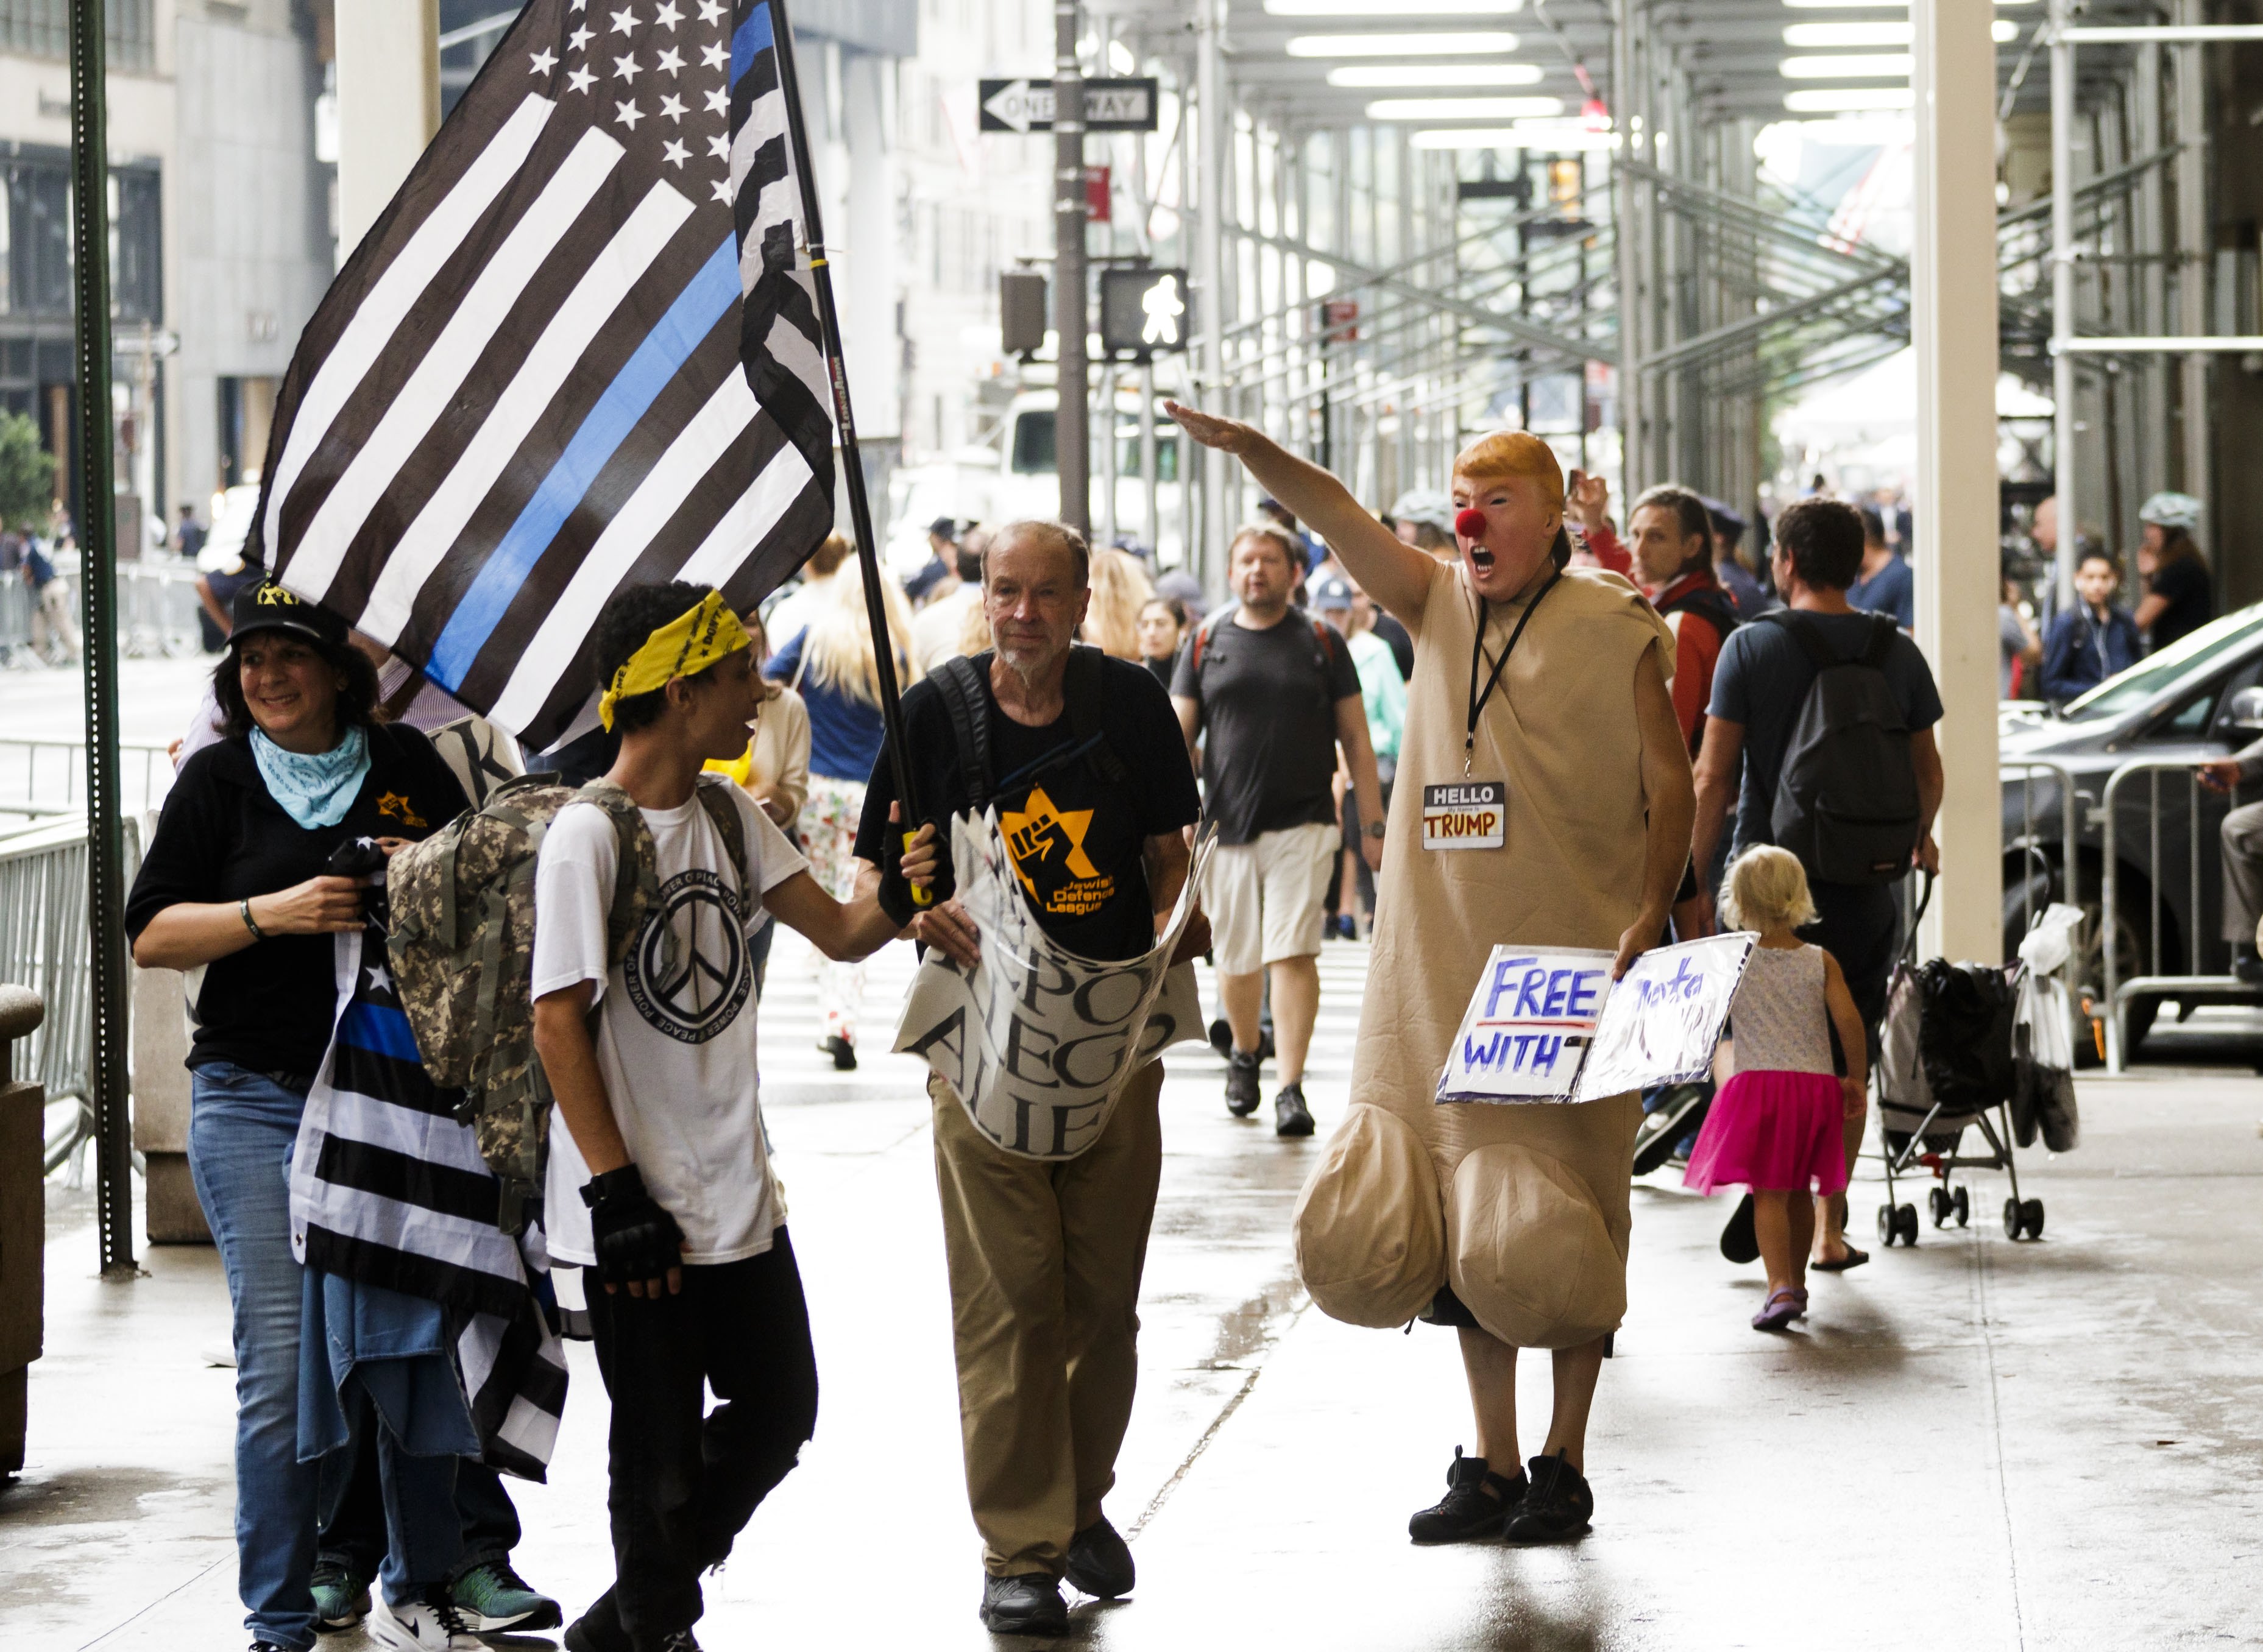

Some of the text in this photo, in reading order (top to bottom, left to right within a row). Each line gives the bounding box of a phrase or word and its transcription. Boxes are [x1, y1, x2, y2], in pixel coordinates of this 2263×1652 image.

[1005, 95, 1055, 118] ONE
[1434, 786, 1494, 805] HELLO
[1424, 812, 1495, 838] TRUMP
[1063, 875, 1114, 892] Jewish
[1046, 902, 1102, 916] League
[628, 976, 654, 1018] POWER
[1484, 957, 1606, 1018] FREE
[656, 1018, 696, 1042] PEACE
[1464, 1031, 1562, 1078] WITH
